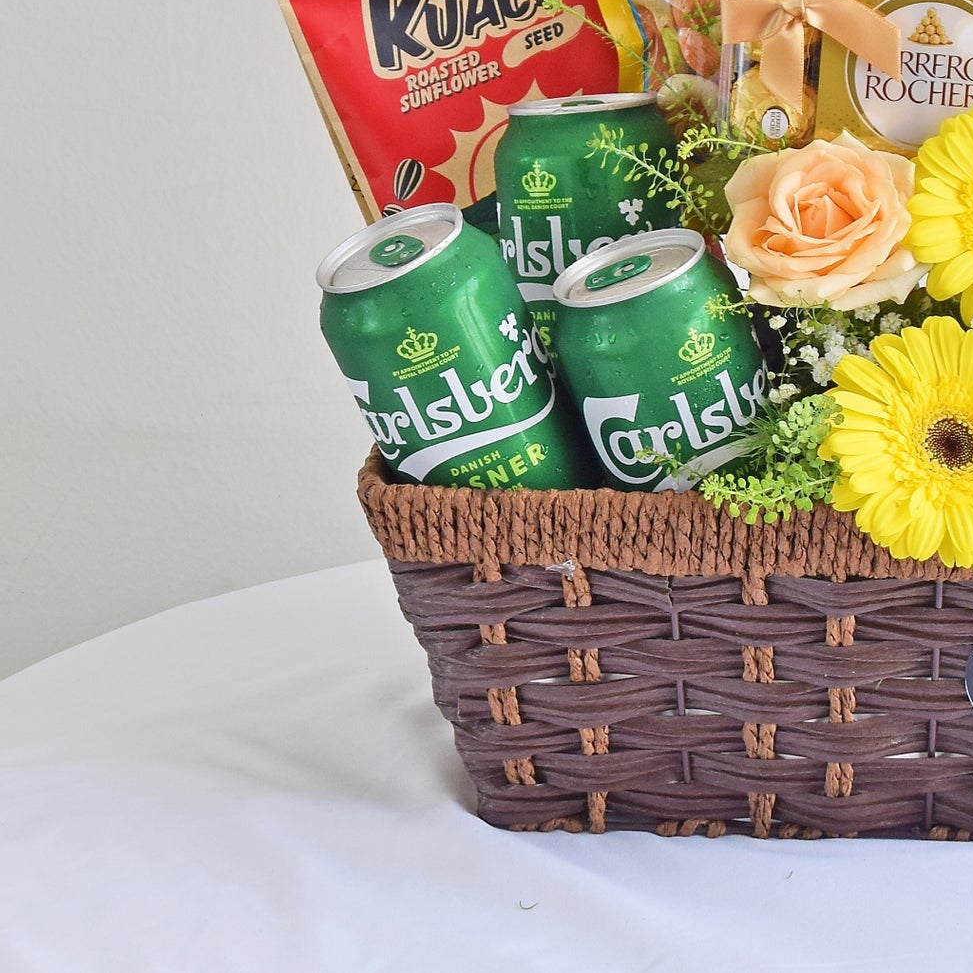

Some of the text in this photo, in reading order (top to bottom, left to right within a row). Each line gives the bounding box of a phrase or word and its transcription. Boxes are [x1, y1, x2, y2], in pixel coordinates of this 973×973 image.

[524, 22, 564, 51] SEED
[400, 61, 502, 114] SUNFLOWER
[405, 51, 482, 92] ROASTED
[449, 449, 501, 477] DANISH
[451, 443, 547, 491] SNER
